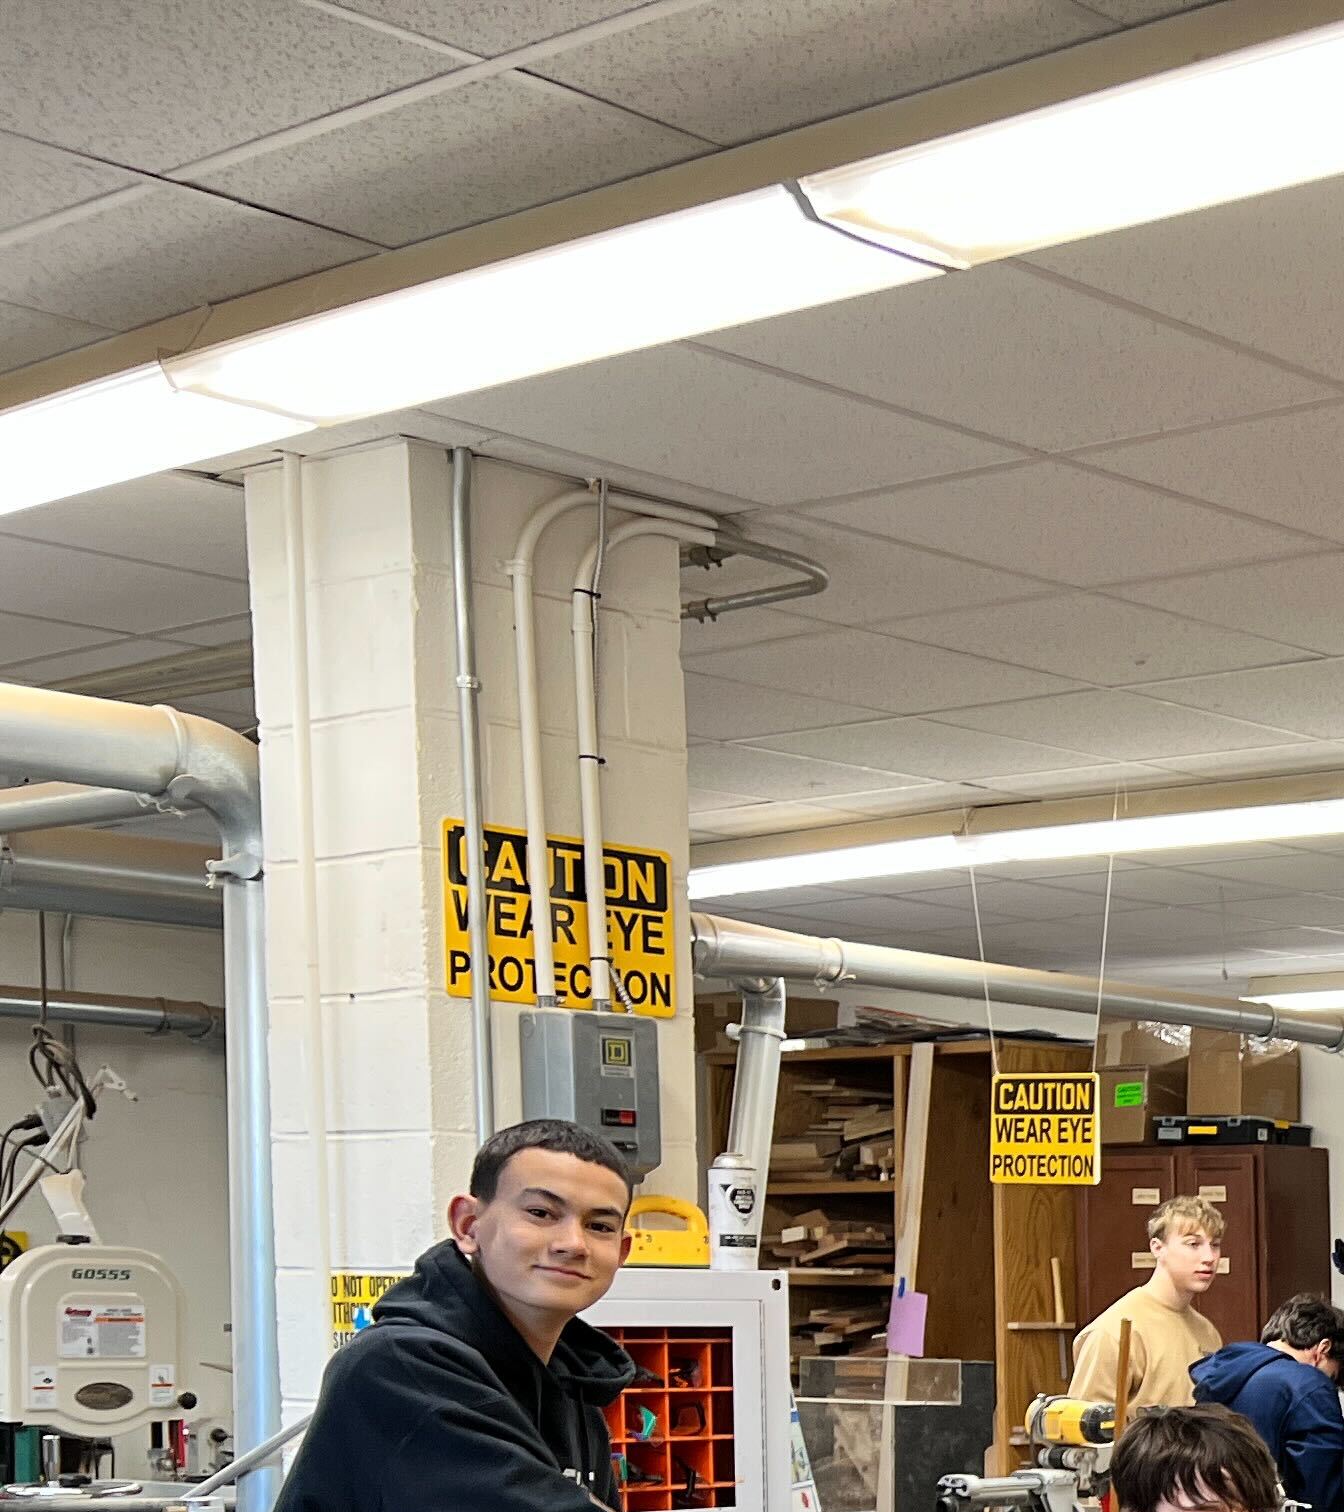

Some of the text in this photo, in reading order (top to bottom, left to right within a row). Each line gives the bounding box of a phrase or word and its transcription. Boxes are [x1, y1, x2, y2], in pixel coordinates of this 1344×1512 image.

[459, 835, 656, 903] CATON
[450, 950, 671, 1007] POTECION
[999, 1082, 1090, 1111] CAUTION
[995, 1117, 1093, 1143] WEAR EYE
[992, 1154, 1094, 1177] PROTECTION
[342, 1275, 362, 1297] NOT
